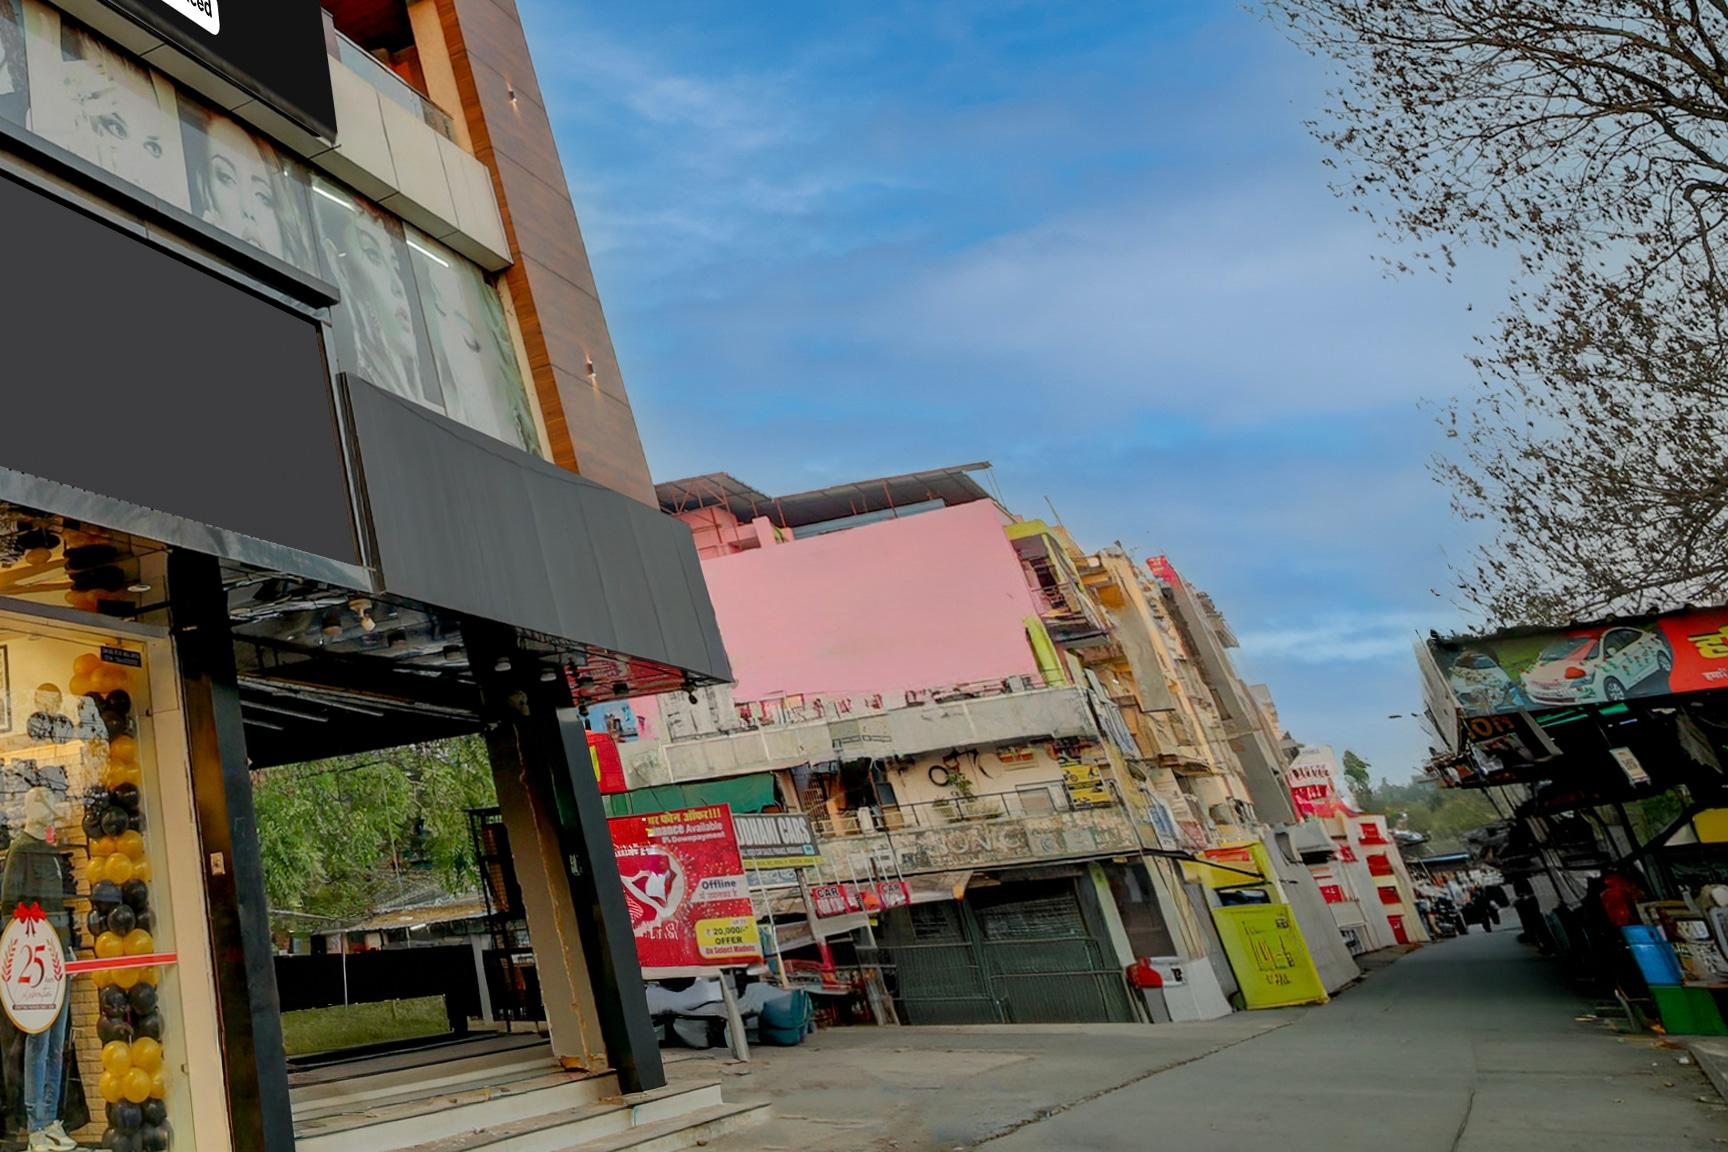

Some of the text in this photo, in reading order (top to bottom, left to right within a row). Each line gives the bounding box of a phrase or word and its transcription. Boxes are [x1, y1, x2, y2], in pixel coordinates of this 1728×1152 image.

[649, 821, 723, 837] inance Available
[777, 816, 811, 844] CARS
[702, 879, 737, 890] Offline
[817, 888, 839, 898] CAR
[715, 937, 743, 945] OFFER
[17, 944, 45, 988] 25
